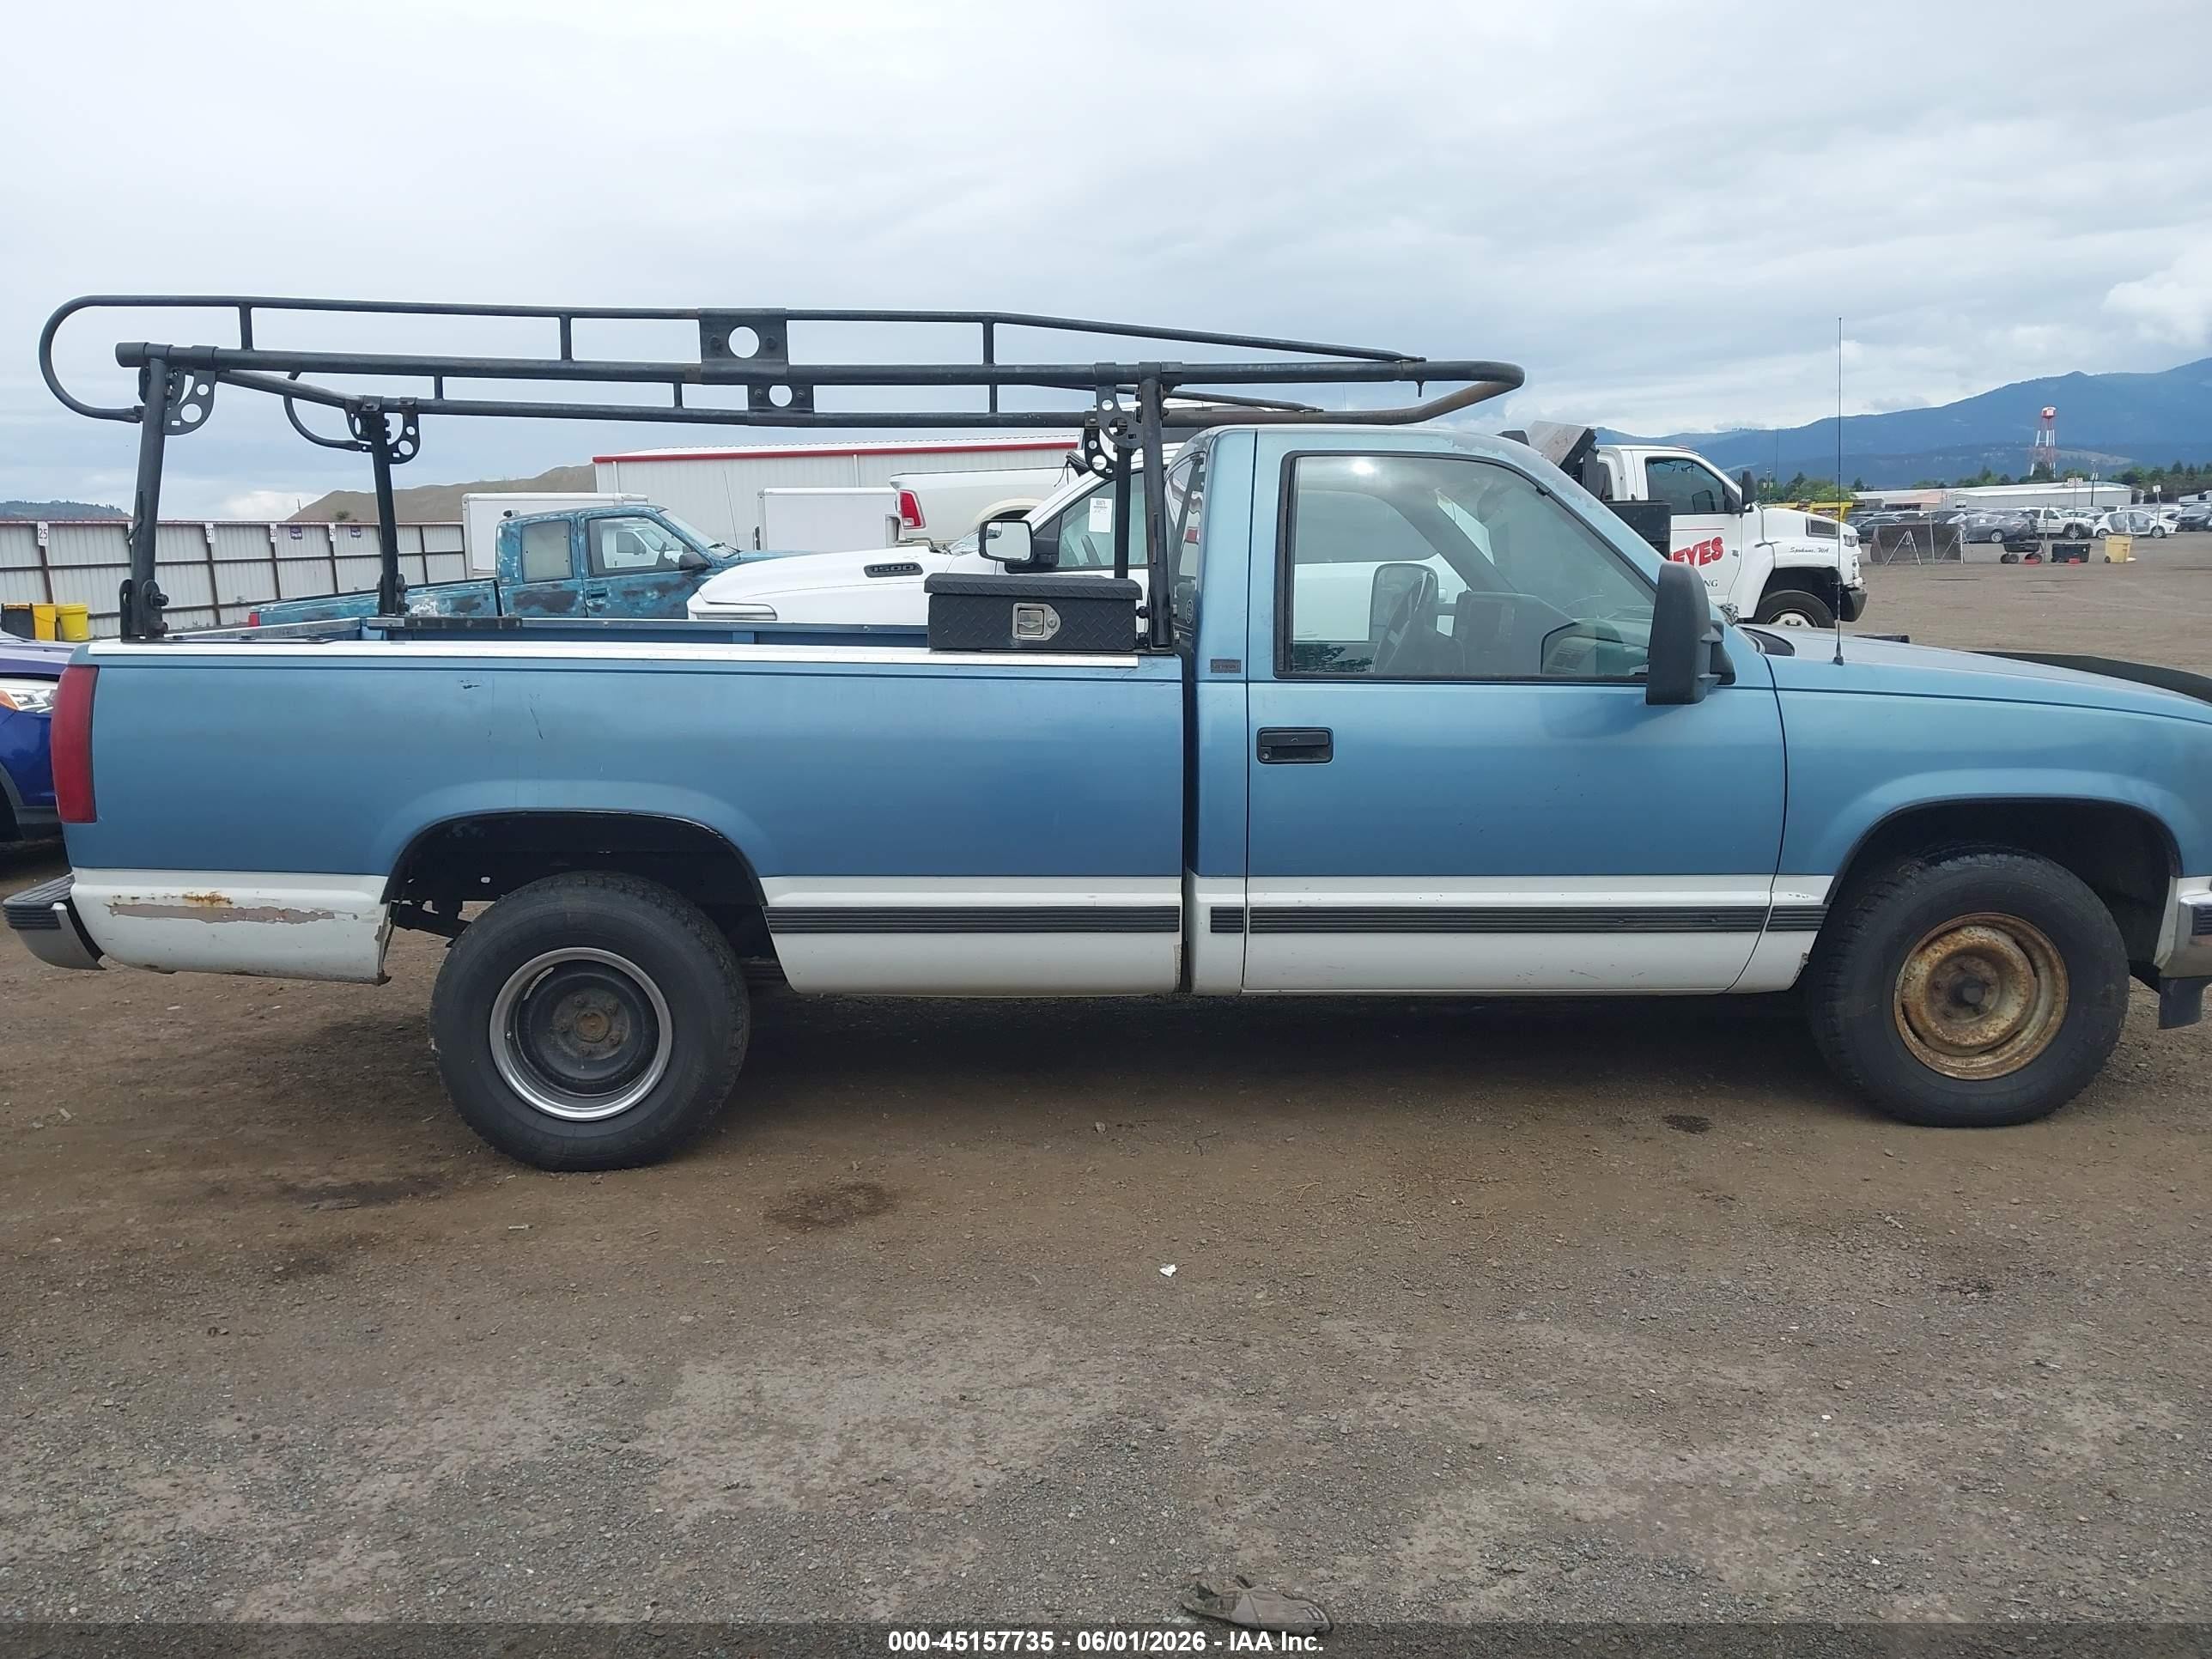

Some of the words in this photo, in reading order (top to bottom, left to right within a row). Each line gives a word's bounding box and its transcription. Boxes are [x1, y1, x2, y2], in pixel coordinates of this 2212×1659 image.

[39, 528, 48, 539] 25
[206, 527, 214, 538] 27
[1668, 536, 1724, 567] EYES
